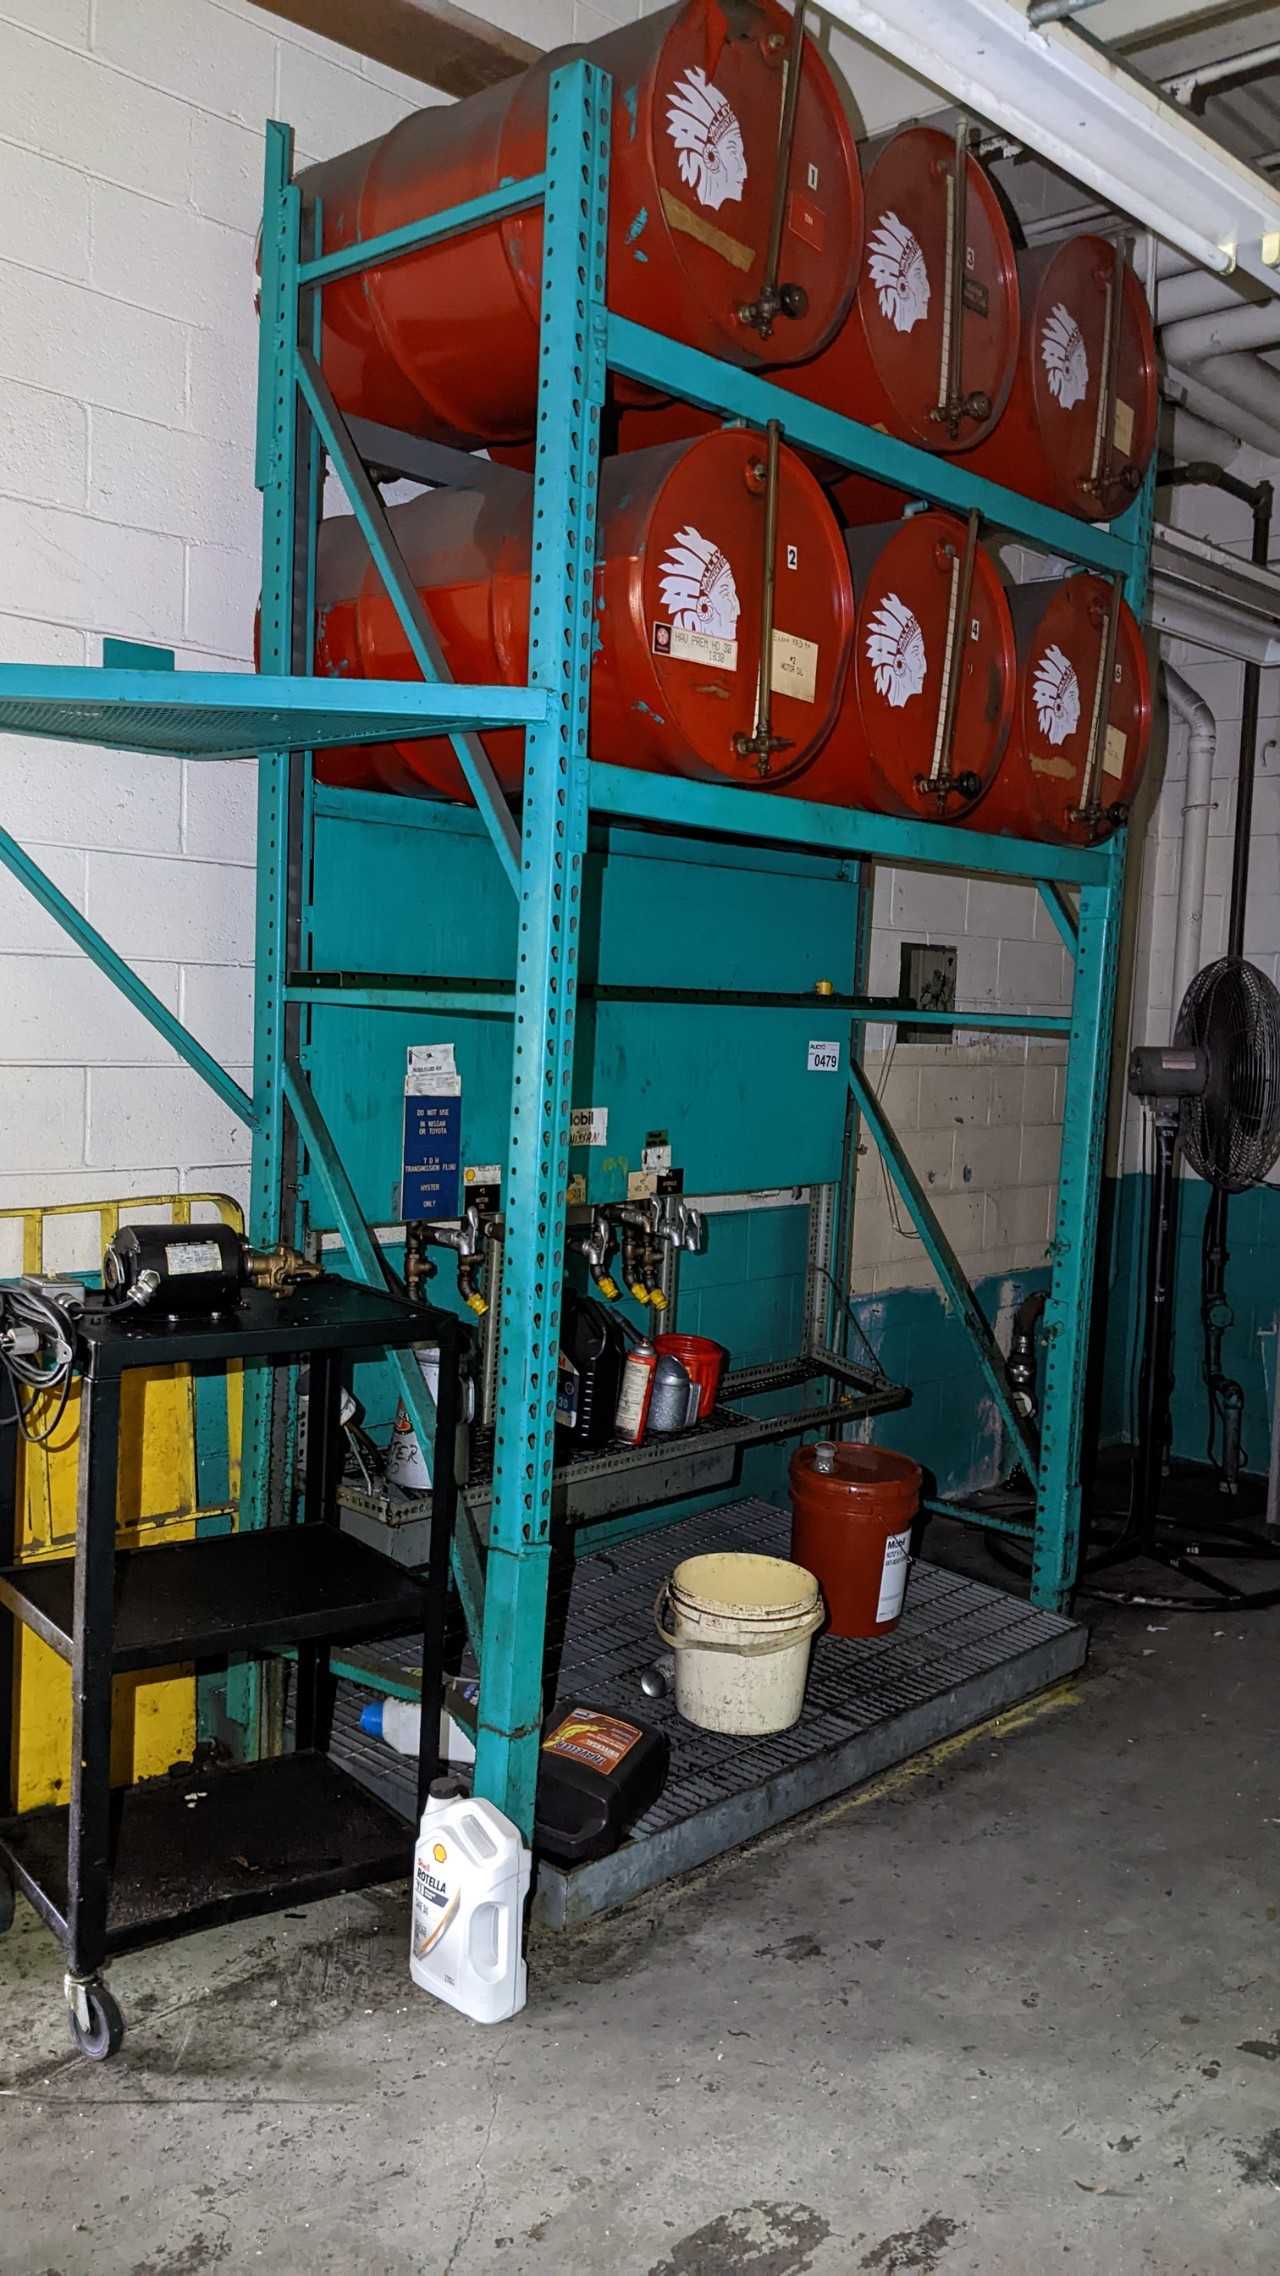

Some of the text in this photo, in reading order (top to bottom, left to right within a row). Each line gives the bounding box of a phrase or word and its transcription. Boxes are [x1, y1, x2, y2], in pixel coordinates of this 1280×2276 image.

[789, 550, 796, 565] 2
[972, 623, 978, 637] 4
[814, 1054, 838, 1068] 0479
[416, 1109, 425, 1117] DO
[570, 1111, 594, 1126] obil
[405, 1164, 441, 1172] TRANSMISSION
[423, 1200, 437, 1208] ONLY
[416, 1866, 447, 1894] ROTELLA
